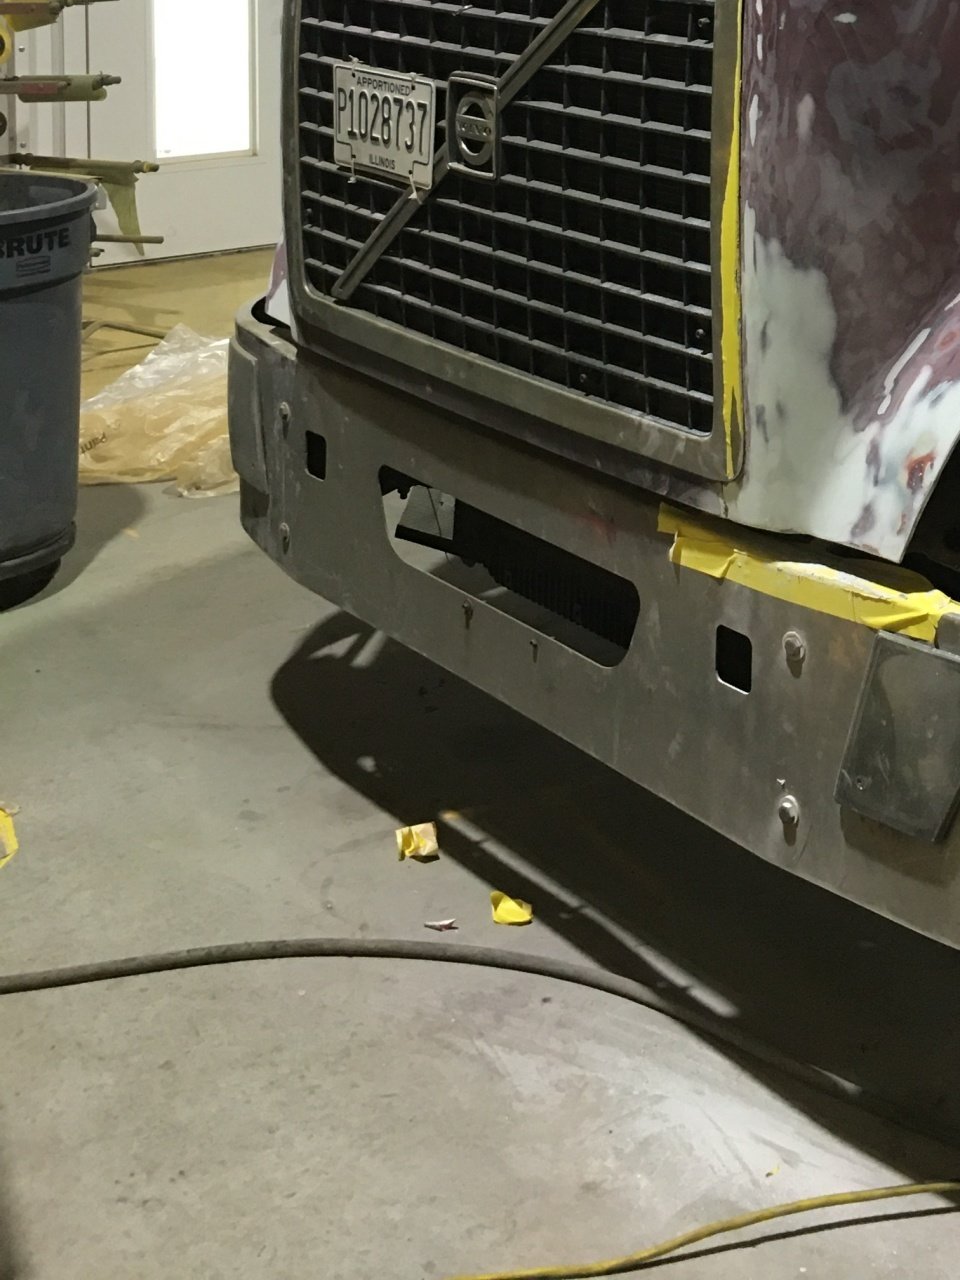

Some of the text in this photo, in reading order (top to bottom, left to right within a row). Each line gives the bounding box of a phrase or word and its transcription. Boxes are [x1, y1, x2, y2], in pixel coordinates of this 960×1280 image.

[356, 76, 411, 97] APPORTIONED
[337, 87, 428, 156] P1028737
[369, 152, 396, 170] ILLINOIS
